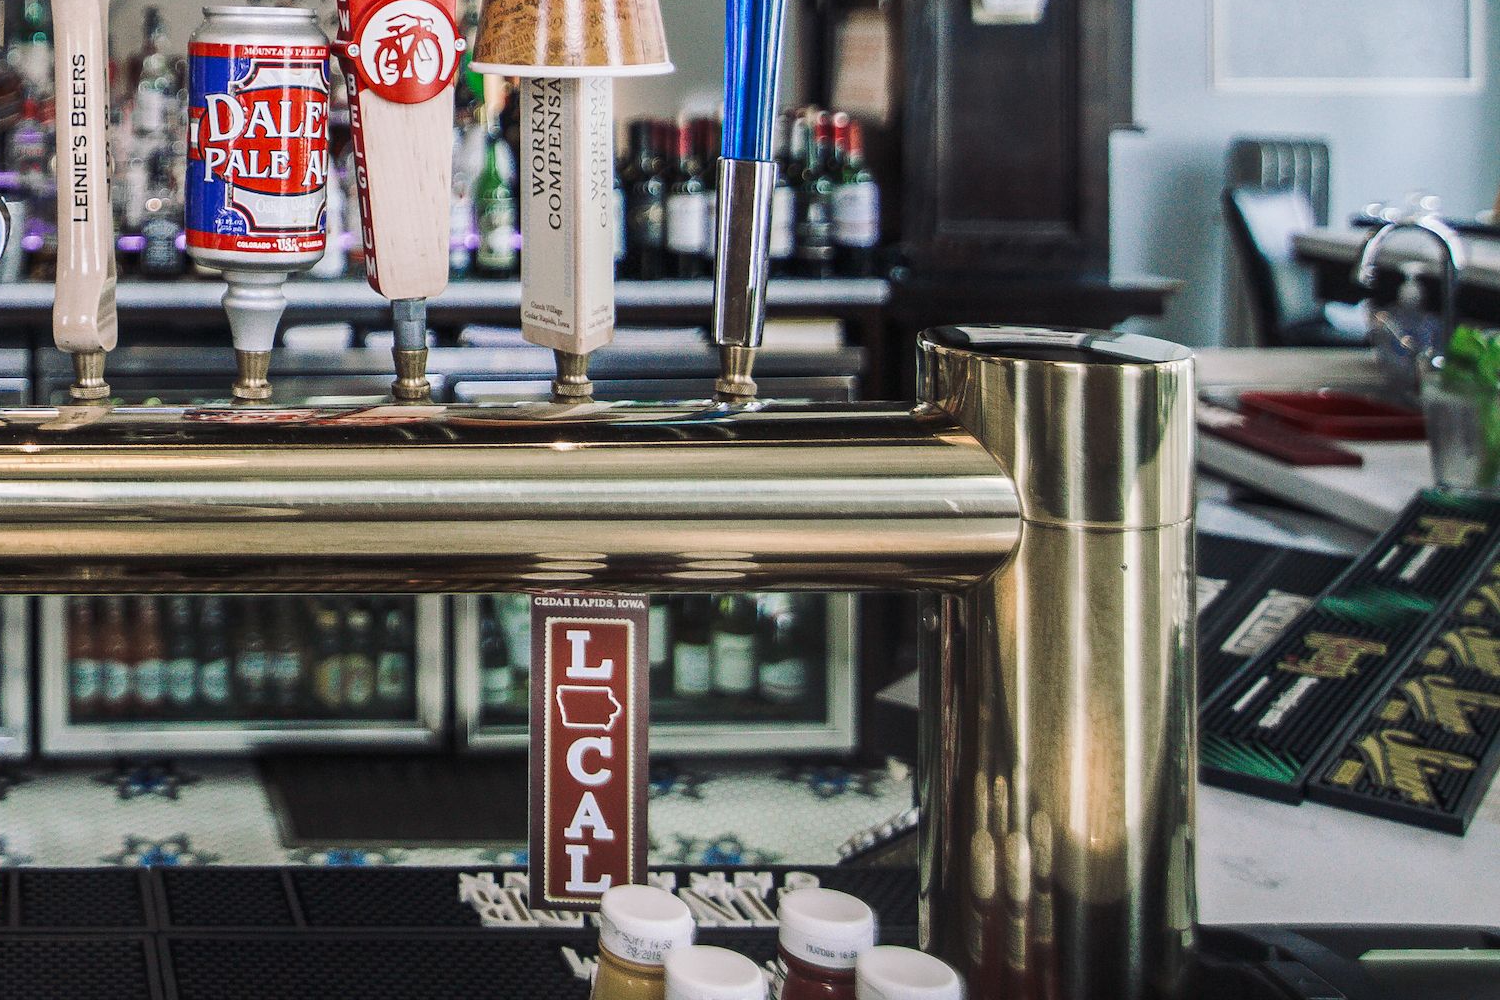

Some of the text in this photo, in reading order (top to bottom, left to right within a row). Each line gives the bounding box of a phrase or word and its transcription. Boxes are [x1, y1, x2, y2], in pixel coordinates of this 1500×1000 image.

[71, 54, 89, 222] LEINIE'S BEERS
[204, 93, 329, 143] DALE'
[203, 147, 292, 183] PALE
[346, 73, 378, 279] BELGIUM
[236, 241, 271, 249] COLORADO
[276, 237, 299, 252] USA
[534, 597, 646, 609] CEDAR RAPIDS, IOWA
